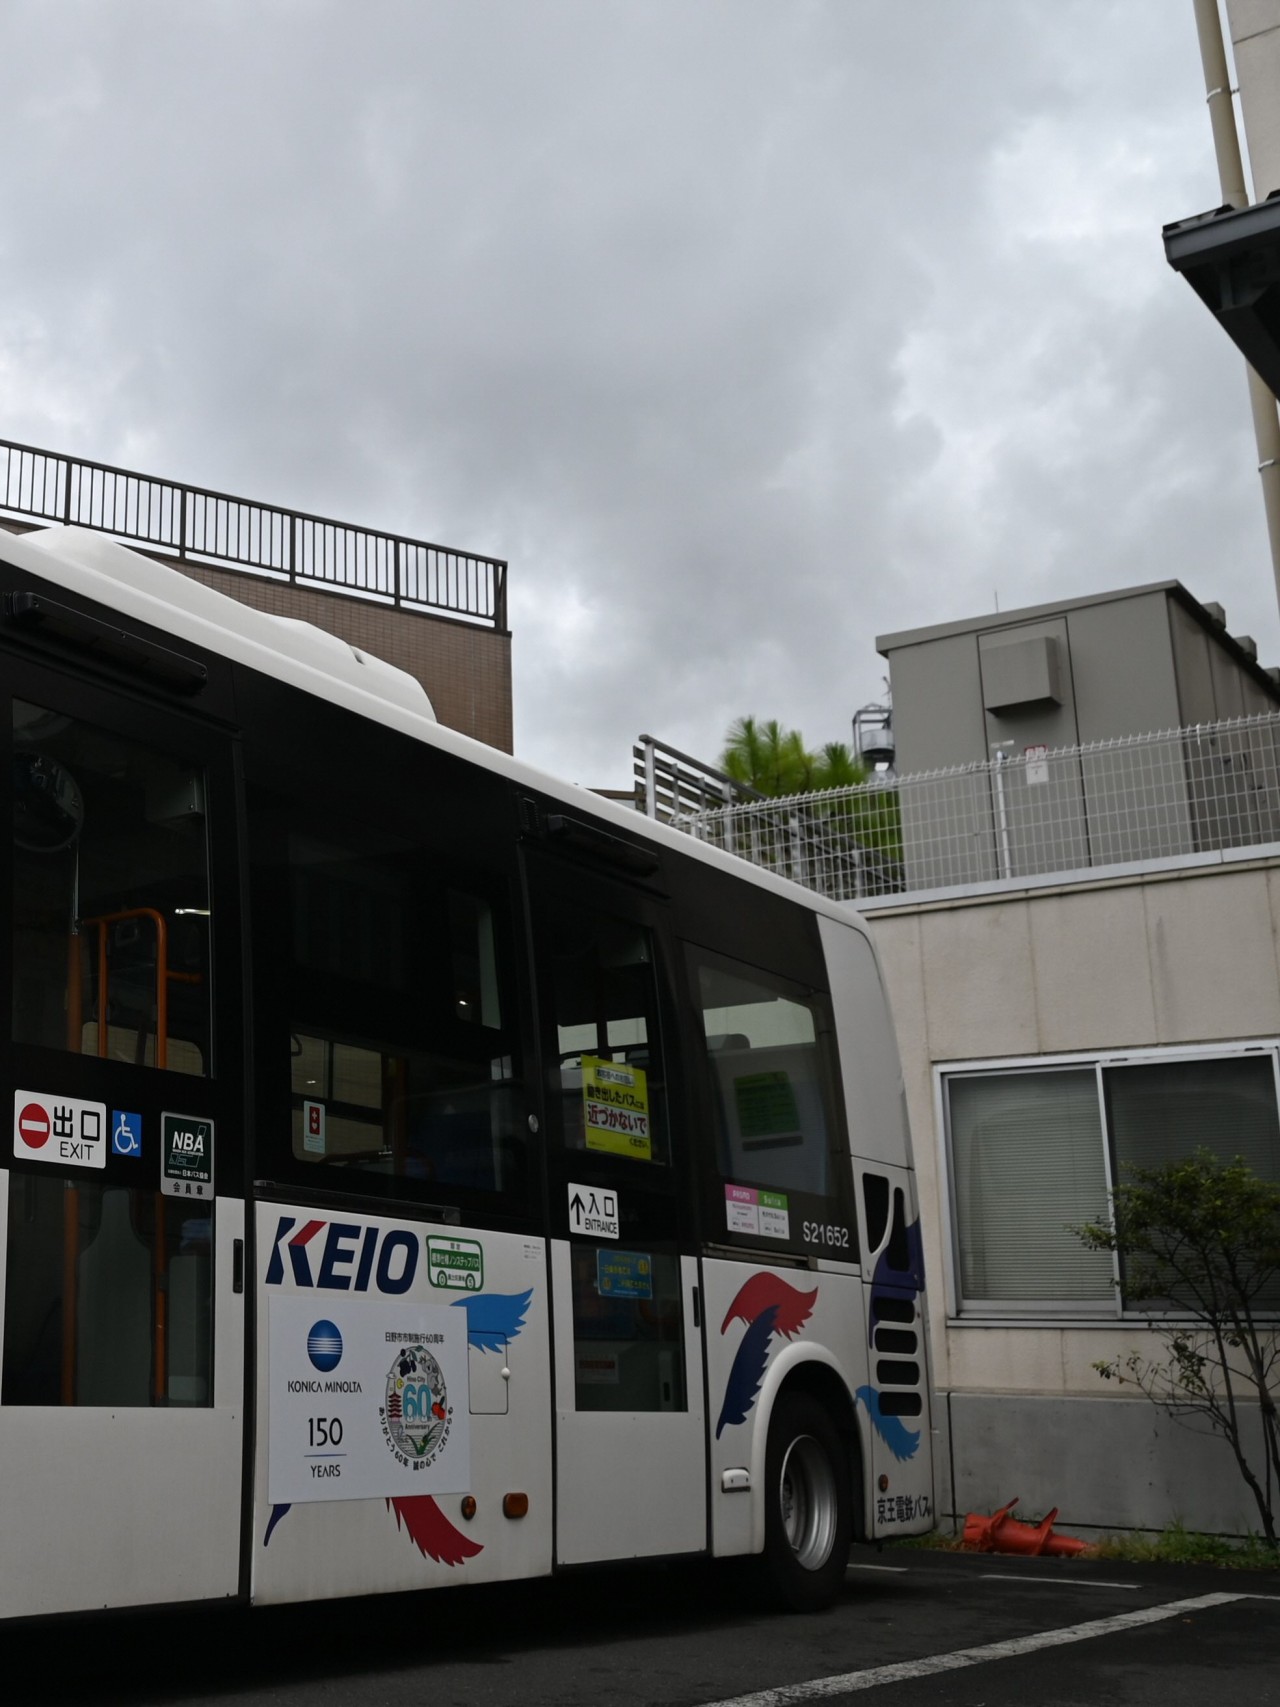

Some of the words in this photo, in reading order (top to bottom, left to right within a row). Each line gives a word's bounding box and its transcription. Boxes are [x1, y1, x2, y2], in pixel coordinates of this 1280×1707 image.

[53, 1105, 100, 1142] 出口
[587, 1104, 647, 1135] 近づかないで
[60, 1141, 94, 1160] EXIT
[172, 1131, 204, 1152] NBA
[589, 1192, 615, 1218] 入口
[585, 1217, 618, 1235] ENTRANCE
[803, 1221, 850, 1248] S21652
[265, 1216, 420, 1295] KEIO
[287, 1380, 323, 1393] KONICA
[324, 1380, 363, 1394] MINOLTA
[308, 1417, 343, 1447] 150
[404, 1423, 430, 1431] Anniversary
[310, 1464, 341, 1478] YEARS
[877, 1495, 930, 1525] 京王電鉄バス
